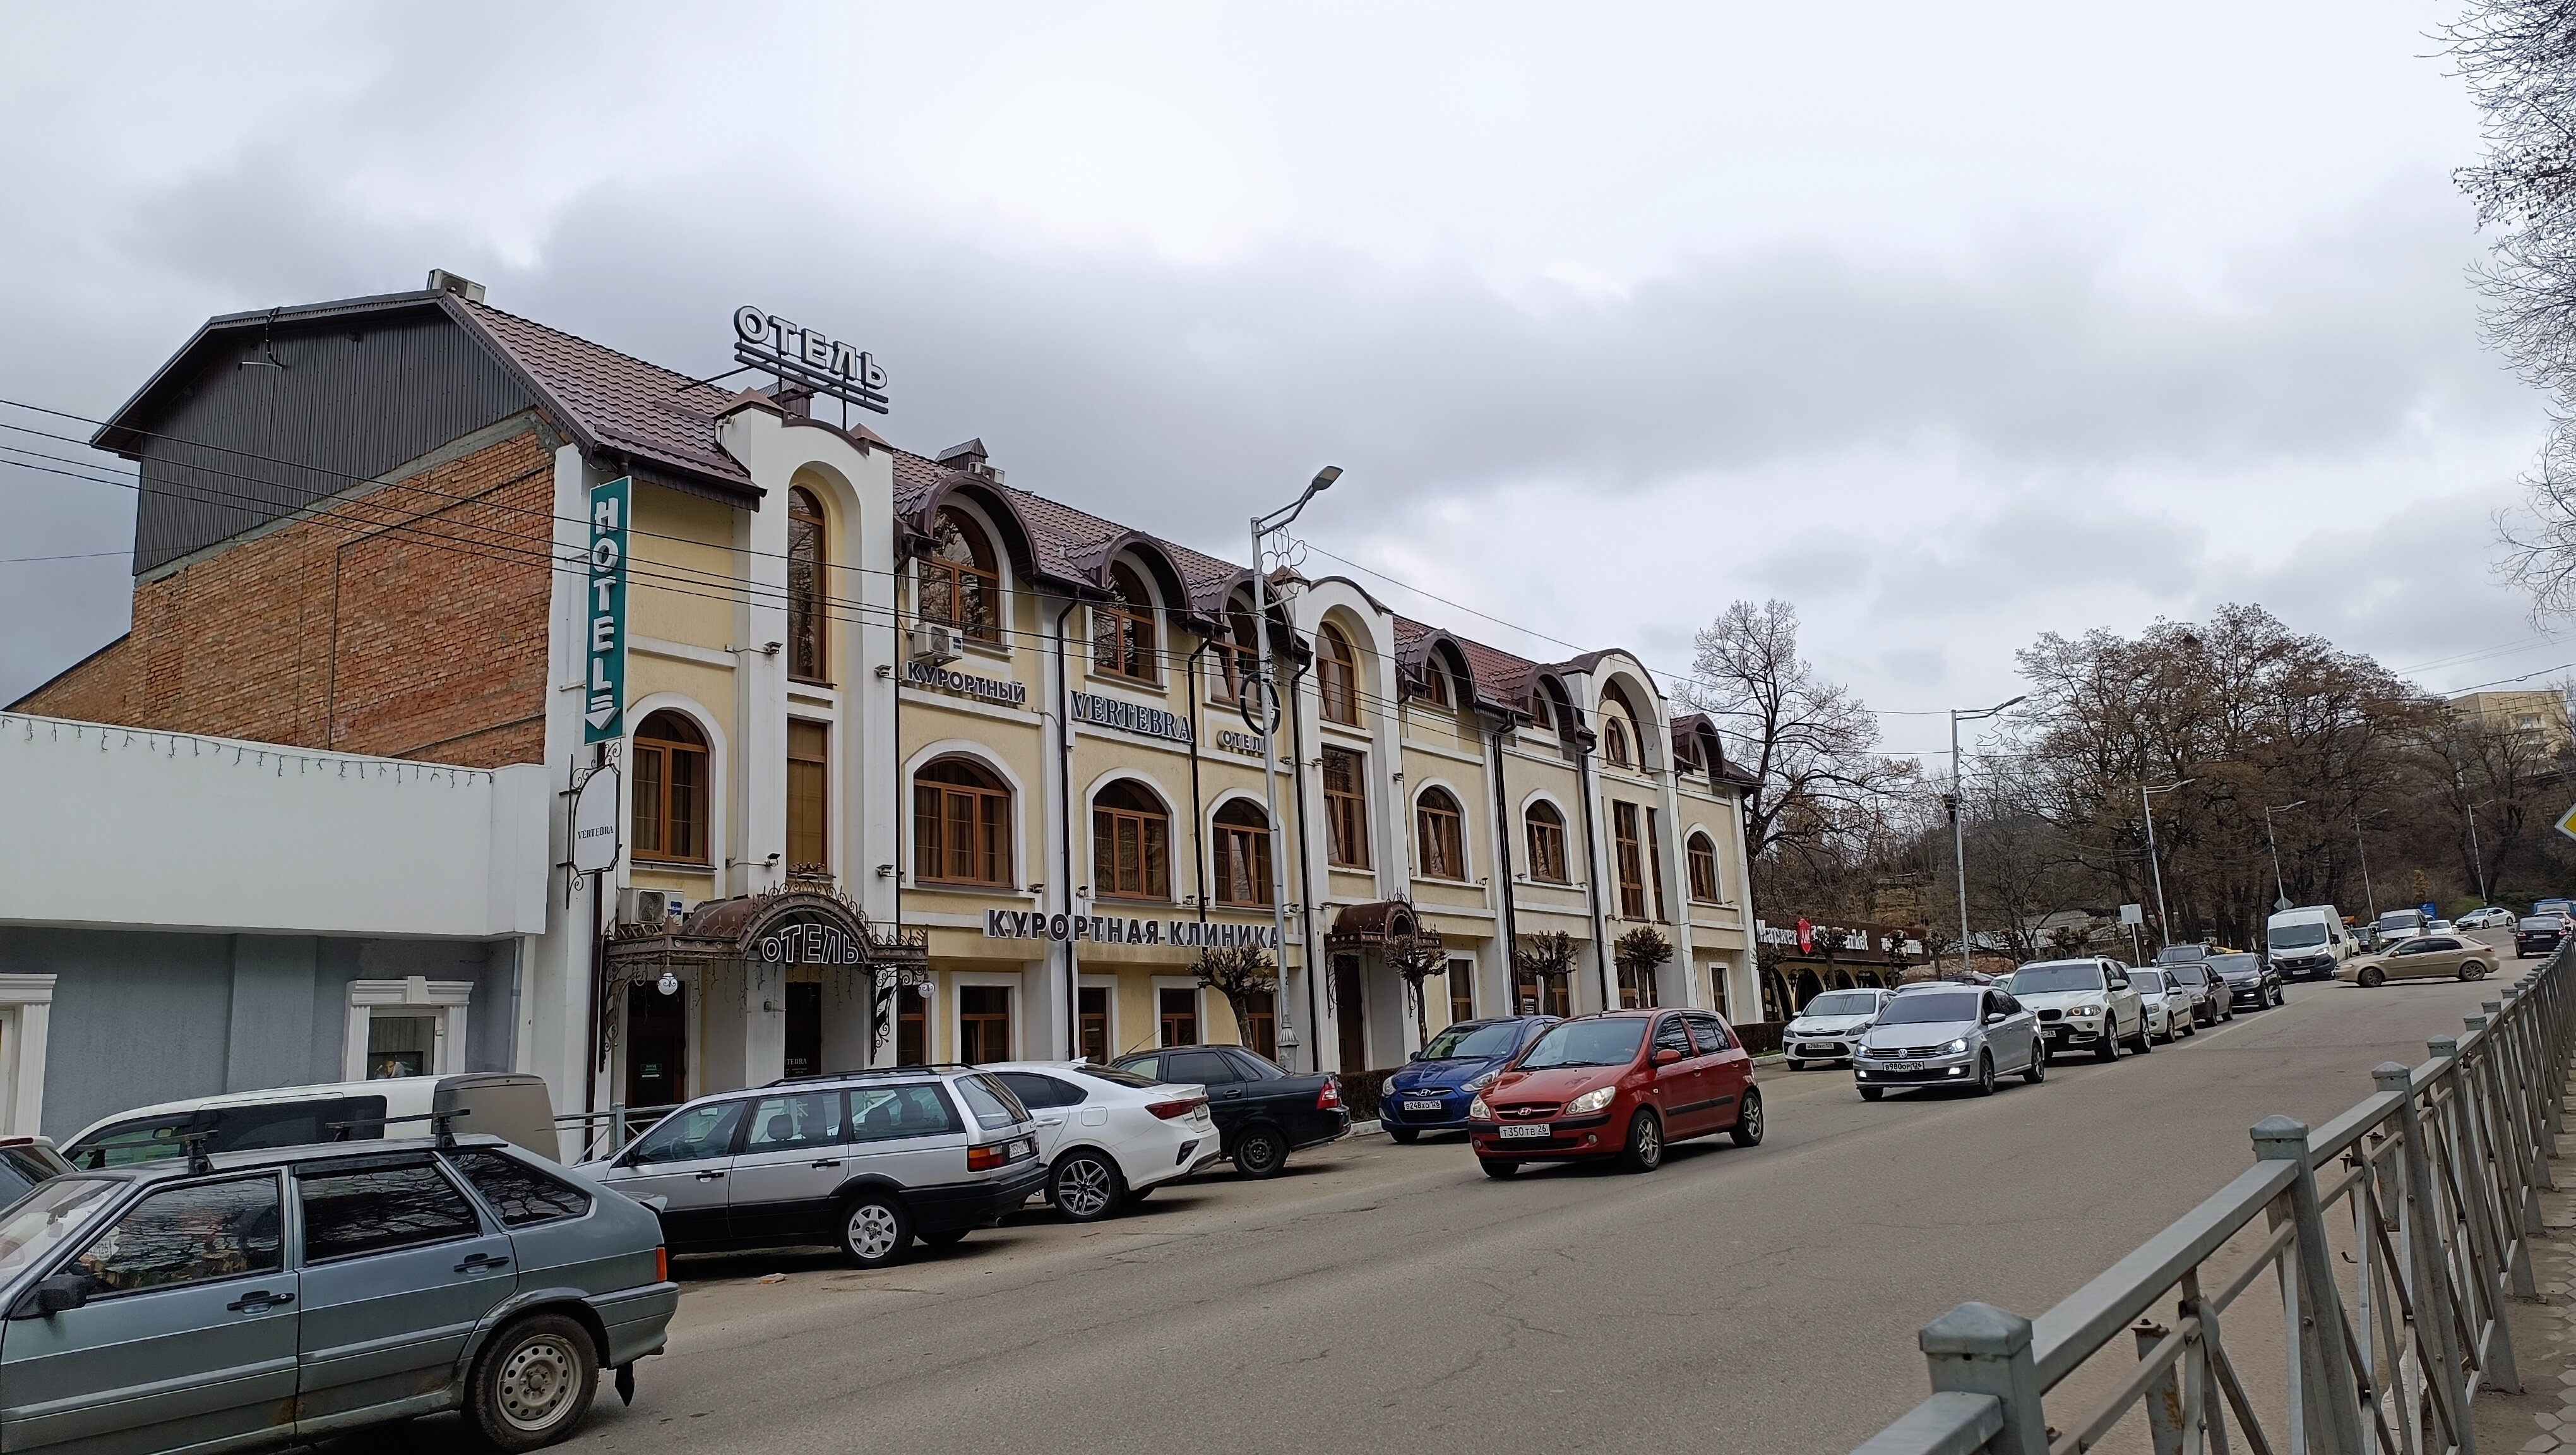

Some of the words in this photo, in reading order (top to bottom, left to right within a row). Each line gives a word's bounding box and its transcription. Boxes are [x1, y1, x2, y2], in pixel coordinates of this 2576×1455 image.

[734, 306, 888, 390] ОТЕЛЬ
[592, 497, 619, 692] HOTEL
[907, 661, 1026, 705] КУРОРТНЫЙ
[1070, 690, 1194, 743] VERTEBRA
[578, 825, 614, 839] VERTEBRA
[761, 923, 859, 964] ОТЕЛЬ
[984, 908, 1159, 945] КУРОРТНАЯ
[1168, 921, 1279, 949] КЛИНИКА
[1503, 1127, 1535, 1137] Т350ТВ
[1537, 1124, 1547, 1132] 26
